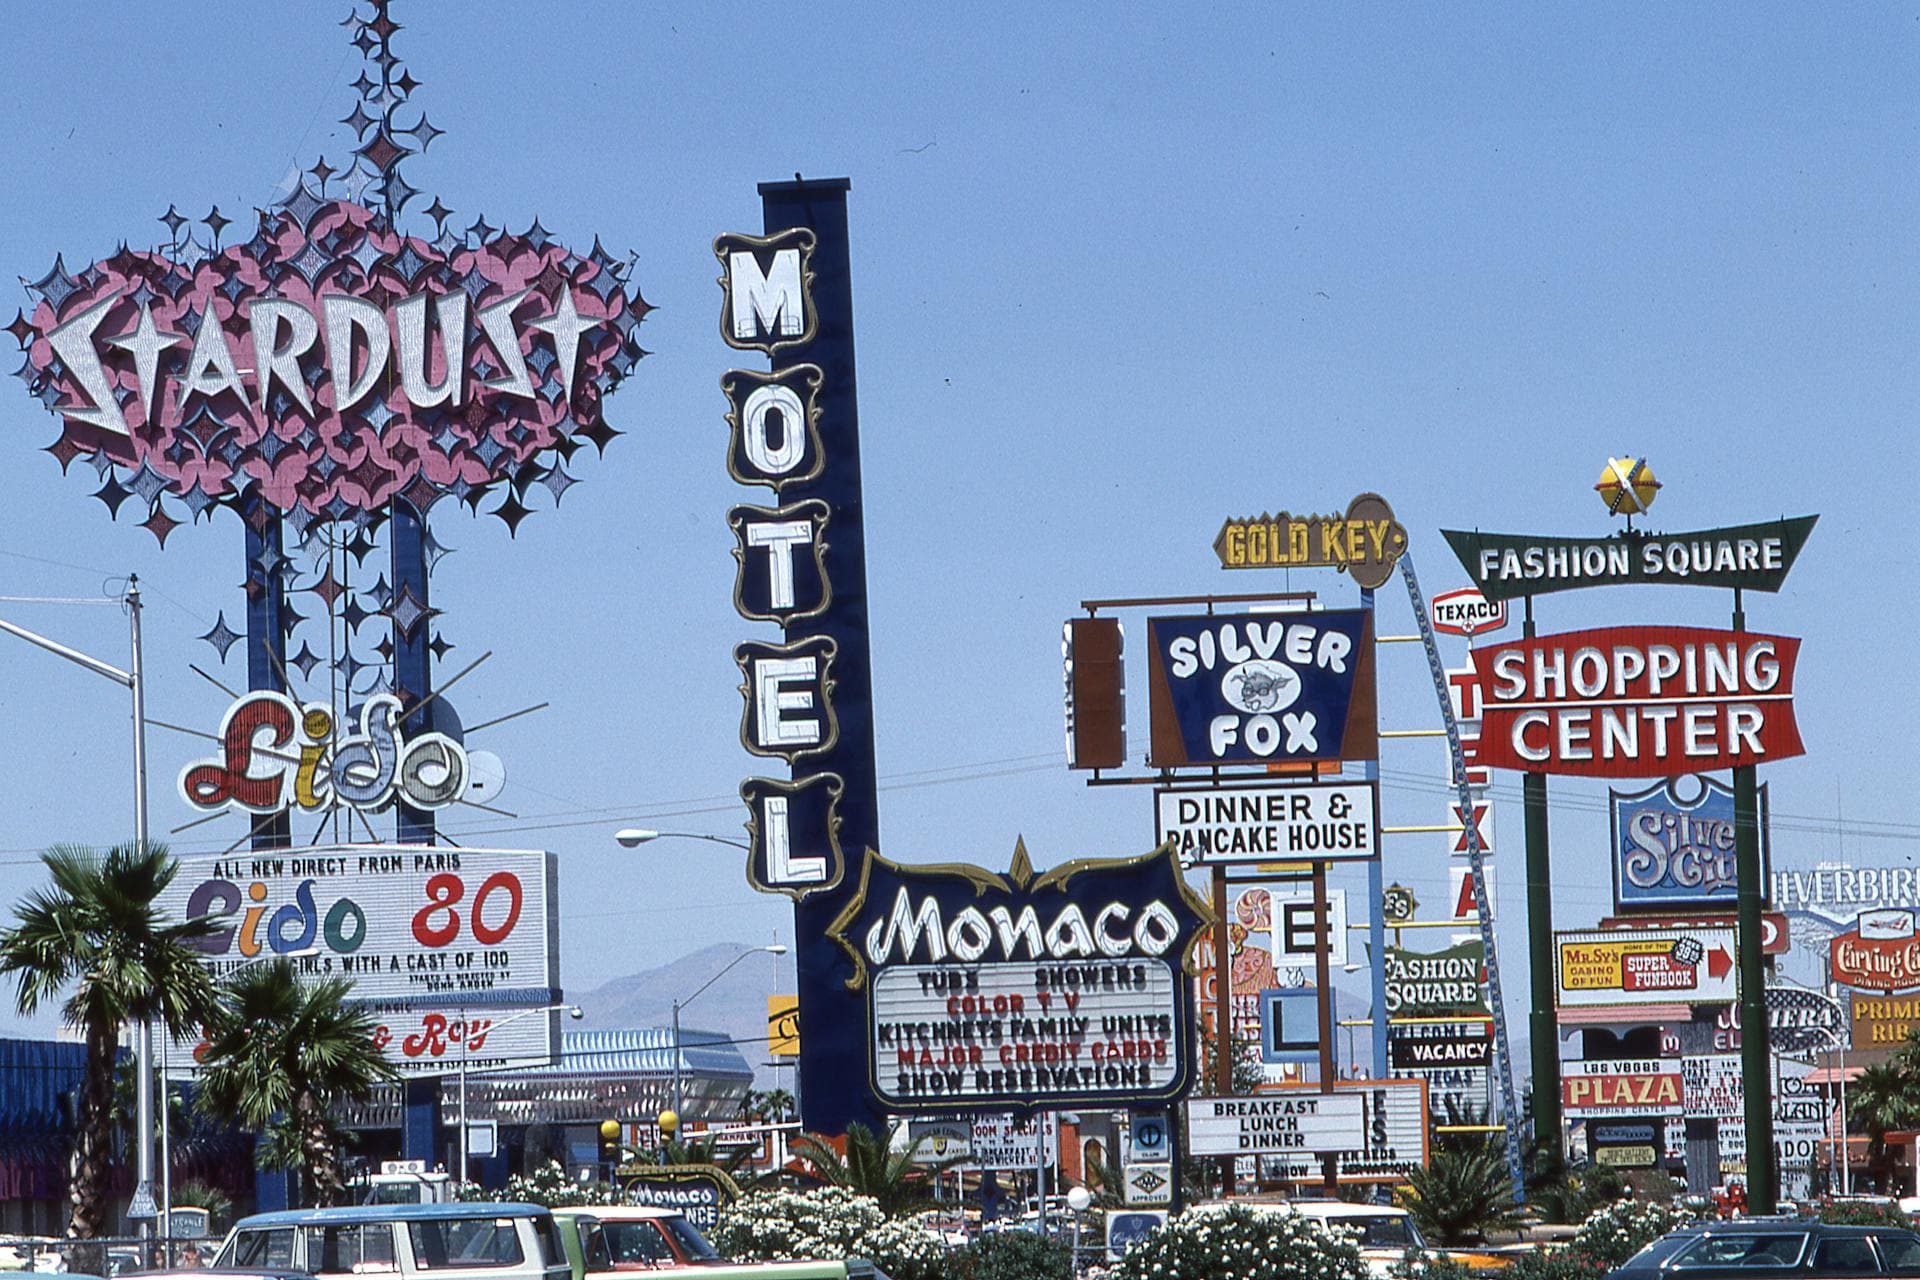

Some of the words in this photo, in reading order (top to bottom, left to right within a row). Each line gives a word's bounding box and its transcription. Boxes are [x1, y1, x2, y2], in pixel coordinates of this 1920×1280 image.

[46, 280, 604, 435] STARDUST
[1225, 522, 1307, 564] GOLD
[1321, 520, 1390, 563] KEY
[729, 250, 827, 883] MOTEL
[1480, 545, 1630, 580] FASHION
[1642, 538, 1783, 576] SQUARE
[1435, 600, 1499, 622] TEXACO
[1169, 621, 1352, 678] SILVER
[1492, 641, 1780, 699] SHOPPING
[1210, 711, 1318, 757] FOX
[1511, 704, 1765, 761] CENTER
[182, 696, 467, 808] Lido
[1178, 794, 1312, 825] DINNER
[1328, 793, 1352, 818] &
[1167, 825, 1277, 855] PANCAKE
[1288, 822, 1366, 851] HOUSE
[1626, 810, 1736, 888] Silve
[213, 861, 243, 878] ALL
[251, 859, 284, 877] NEW
[291, 858, 347, 876] DIRECT
[359, 855, 402, 875] FROM
[414, 854, 461, 872] PARIS
[186, 879, 367, 957] Lido
[411, 871, 523, 948] 80
[866, 886, 1180, 964] Monaco
[343, 955, 380, 973] WITH
[390, 955, 399, 971] A
[407, 954, 448, 971] CAST
[456, 952, 474, 969] OF
[484, 951, 509, 967] 100
[1570, 966, 1614, 975] CASINO
[1627, 957, 1670, 972] SUPER
[1837, 941, 1904, 978] Carving
[918, 971, 979, 994] TUBS
[1035, 965, 1146, 990] SHOWERS
[1572, 977, 1587, 986] OF
[1590, 976, 1612, 985] FUN
[1635, 971, 1692, 987] FUNBOOK
[946, 994, 1025, 1015] COLOR
[1384, 982, 1477, 1010] SQUARE
[1855, 1001, 1920, 1020] PRIME
[403, 1013, 491, 1057] Roy
[1010, 1017, 1089, 1041] FAMILY
[1103, 1015, 1171, 1037] UNITS
[1872, 1023, 1910, 1042] RIB
[897, 1045, 984, 1068] MAJOR
[1000, 1043, 1081, 1066] CREDIT
[1091, 1040, 1167, 1063] CARDS
[1412, 1043, 1488, 1061] VACANCY
[898, 1071, 964, 1094] SHOW
[976, 1065, 1151, 1091] RESERVATIONS
[1584, 1062, 1608, 1073] LAS
[1614, 1061, 1660, 1073] VEGAS
[1570, 1076, 1679, 1105] PLAZA
[1214, 1100, 1318, 1116] BREAKFAST
[1581, 1107, 1626, 1115] SHOPPING
[1632, 1106, 1667, 1114] CENTER
[1240, 1117, 1298, 1133] LUNCH
[1239, 1133, 1305, 1149] DINNER
